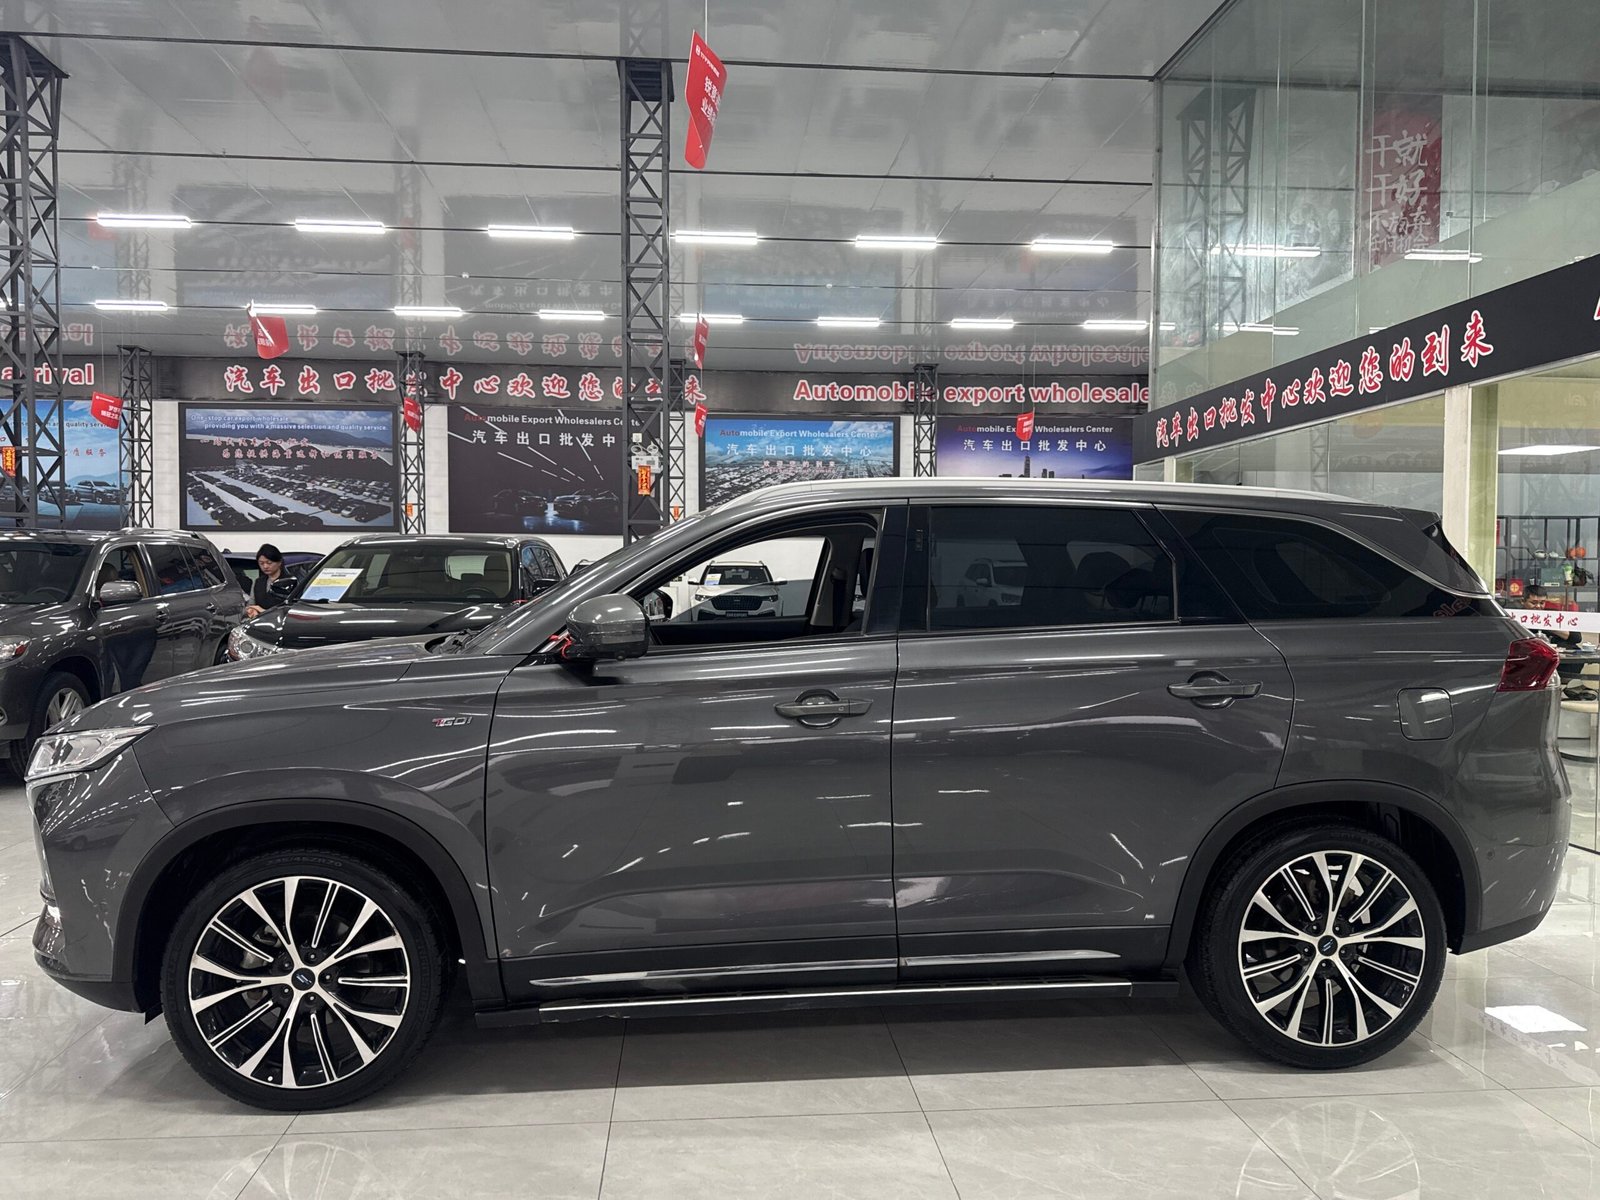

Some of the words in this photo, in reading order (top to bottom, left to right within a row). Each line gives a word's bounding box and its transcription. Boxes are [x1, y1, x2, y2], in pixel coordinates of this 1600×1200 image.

[1, 362, 95, 386] arival
[1155, 309, 1494, 448] 汽车出口批发中心欢迎您的到来
[944, 383, 1025, 406] export
[1029, 382, 1150, 403] wholesale
[204, 422, 235, 430] providing
[340, 424, 362, 432] quality
[464, 412, 520, 424] Automobile
[521, 414, 553, 426] Export
[555, 415, 612, 426] Wholesalers
[613, 417, 646, 428] Cete
[720, 429, 768, 438] Automobile
[769, 429, 798, 439] Export
[799, 429, 849, 438] Wholesalers
[957, 425, 1005, 433] Automobile
[1034, 425, 1085, 433] Wholesalers
[1086, 425, 1114, 433] Center
[472, 429, 617, 447] 汽车出口批发中
[963, 439, 1107, 452] 汽车出口批发中心
[726, 443, 873, 457] 汽车出口批发中心
